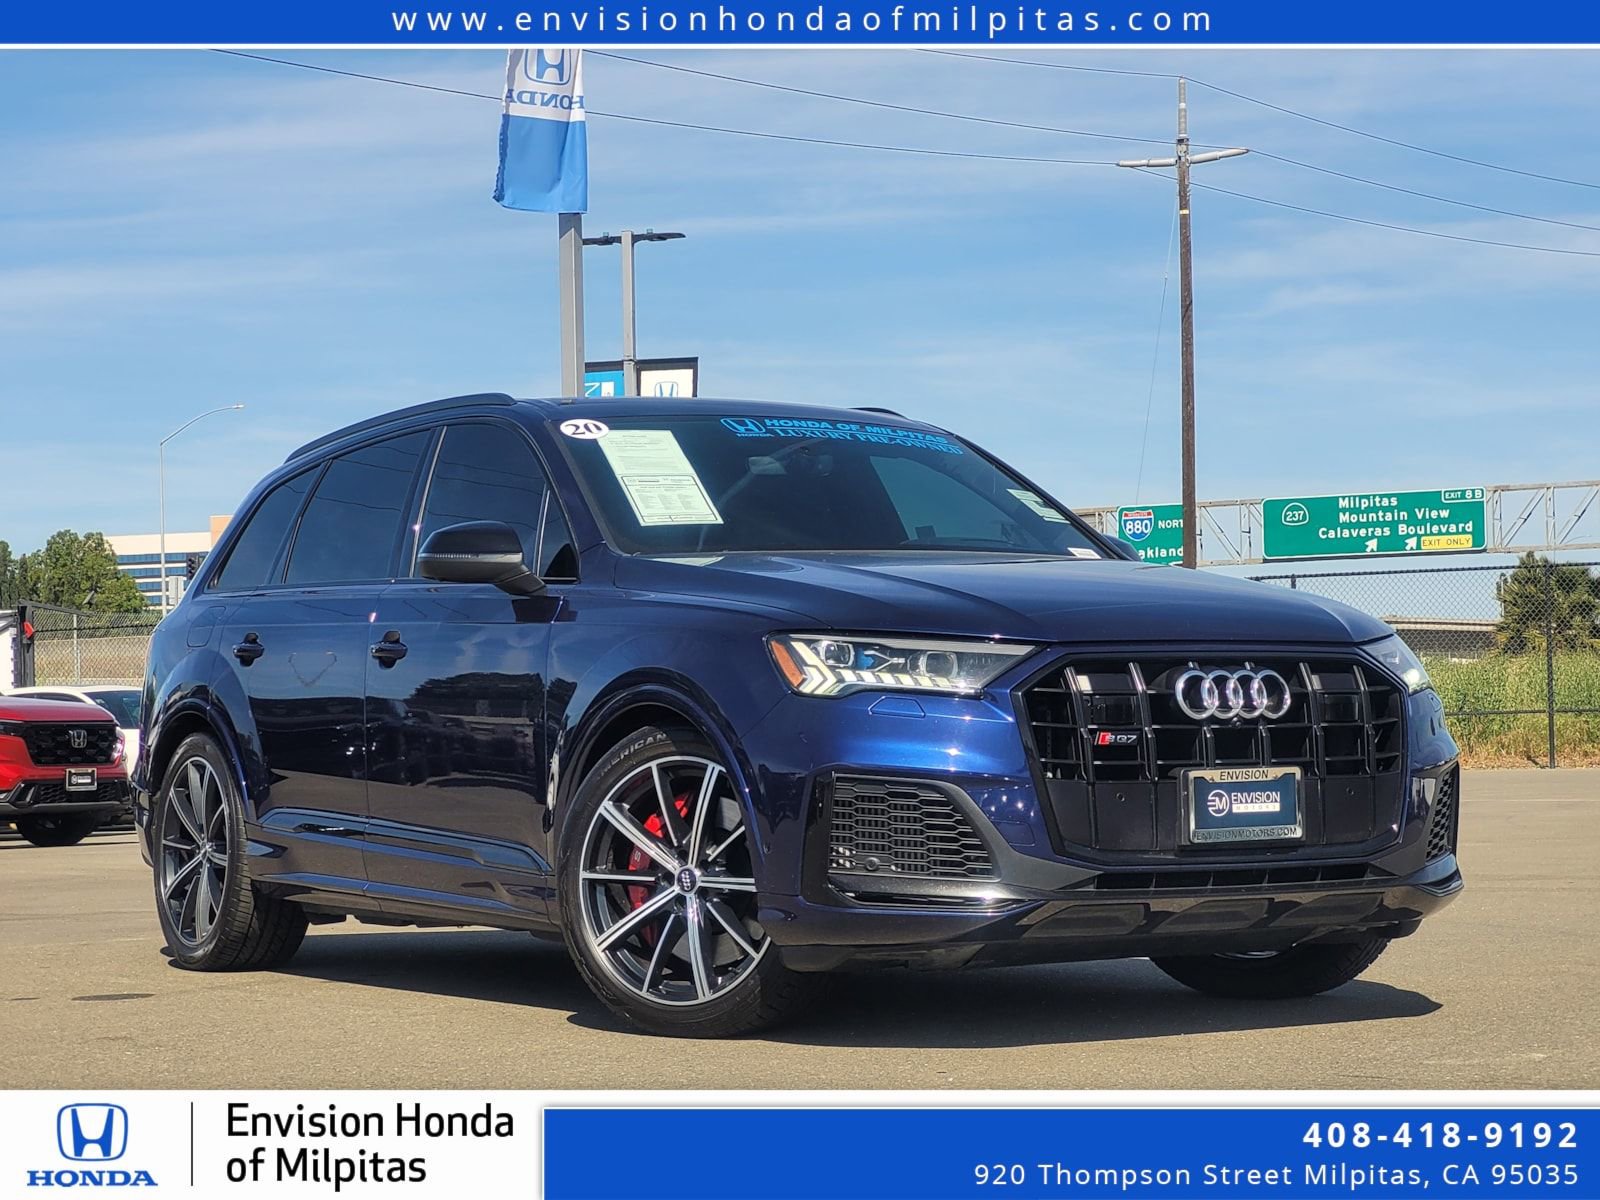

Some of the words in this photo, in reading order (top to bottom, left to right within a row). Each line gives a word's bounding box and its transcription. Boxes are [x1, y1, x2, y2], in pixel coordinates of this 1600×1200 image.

[565, 422, 603, 436] 20
[764, 418, 834, 430] HONDA
[836, 422, 861, 432] OF
[864, 426, 949, 444] MILPITAS
[776, 429, 853, 440] LUXURY
[1445, 491, 1462, 500] EXIT
[1338, 496, 1398, 510] Milpitas
[1286, 510, 1305, 522] 237
[1339, 509, 1408, 524] Mountain
[1414, 507, 1450, 520] View
[1126, 520, 1151, 534] 880
[1158, 519, 1184, 529] NORT
[1318, 526, 1391, 540] Calaveras
[1398, 520, 1473, 536] Boulevard
[1422, 538, 1441, 547] EXIT
[1446, 537, 1471, 546] ONLY
[1138, 546, 1184, 560] akland
[1219, 769, 1269, 781] ENVISION
[1231, 791, 1281, 804] ENVISION
